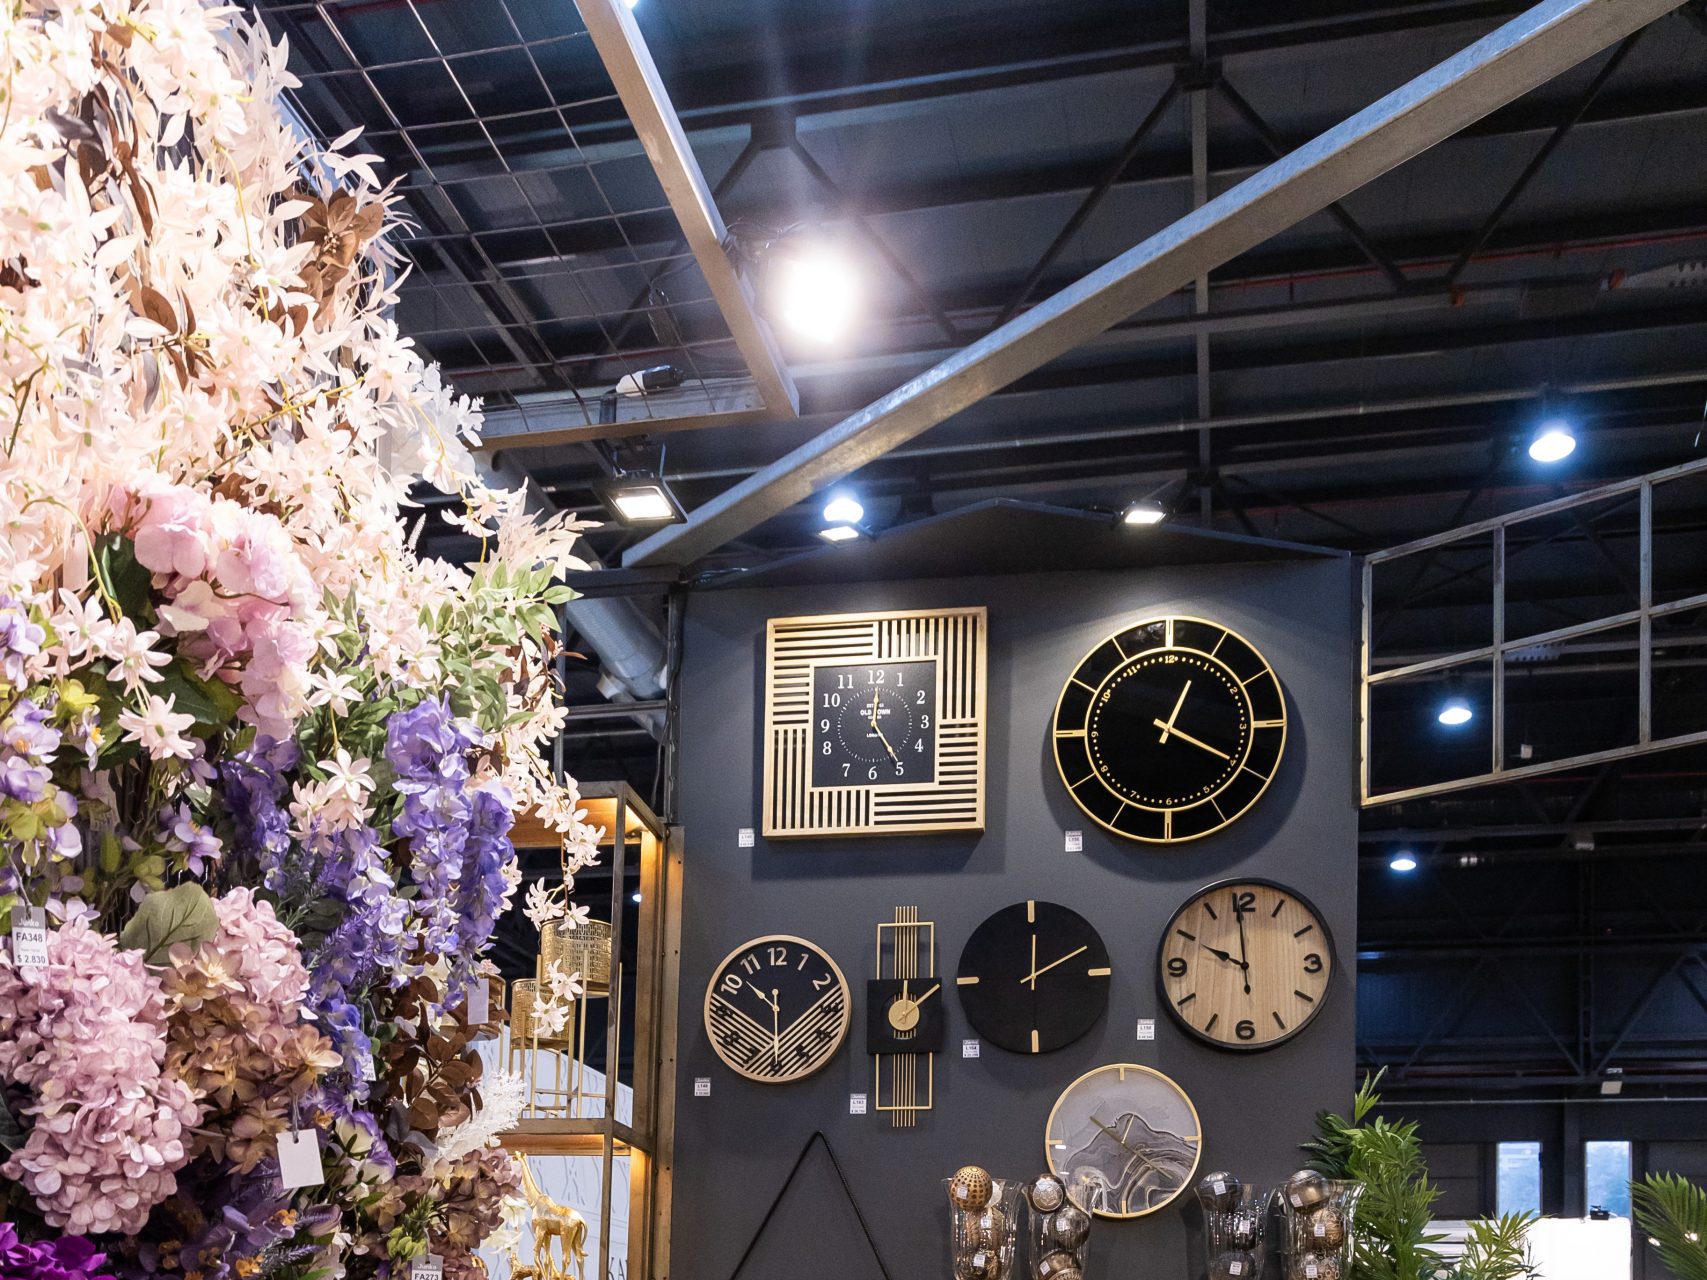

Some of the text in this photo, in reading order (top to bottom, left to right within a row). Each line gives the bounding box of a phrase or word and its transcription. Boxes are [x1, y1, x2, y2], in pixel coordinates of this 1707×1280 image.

[1164, 656, 1175, 664] 12
[868, 670, 885, 684] 12
[1126, 666, 1138, 676] 11
[838, 674, 854, 689] 11
[896, 672, 904, 686] 1
[916, 690, 926, 704] 2
[1101, 691, 1110, 703] 10
[1230, 686, 1238, 694] 2
[823, 693, 840, 708] 10
[820, 719, 830, 733] 9
[920, 714, 930, 729] 3
[822, 741, 832, 755] 8
[914, 738, 924, 752] 4
[896, 762, 904, 776] 5
[1230, 759, 1237, 767] 4
[842, 764, 851, 777] 7
[868, 766, 878, 780] 6
[1130, 790, 1137, 798] 7
[1202, 786, 1210, 794] 5
[1166, 798, 1173, 806] 6
[1232, 892, 1256, 913] 12
[16, 932, 43, 943] FA348
[17, 954, 46, 964] $ 2.830
[767, 947, 788, 966] 12
[797, 953, 810, 972] 1
[1303, 953, 1323, 974] 3
[740, 953, 761, 975] 11
[1167, 957, 1188, 978] 9
[720, 974, 743, 996] 10
[812, 972, 832, 991] 2
[1235, 1020, 1256, 1040] 6
[414, 1273, 439, 1280] FA273
